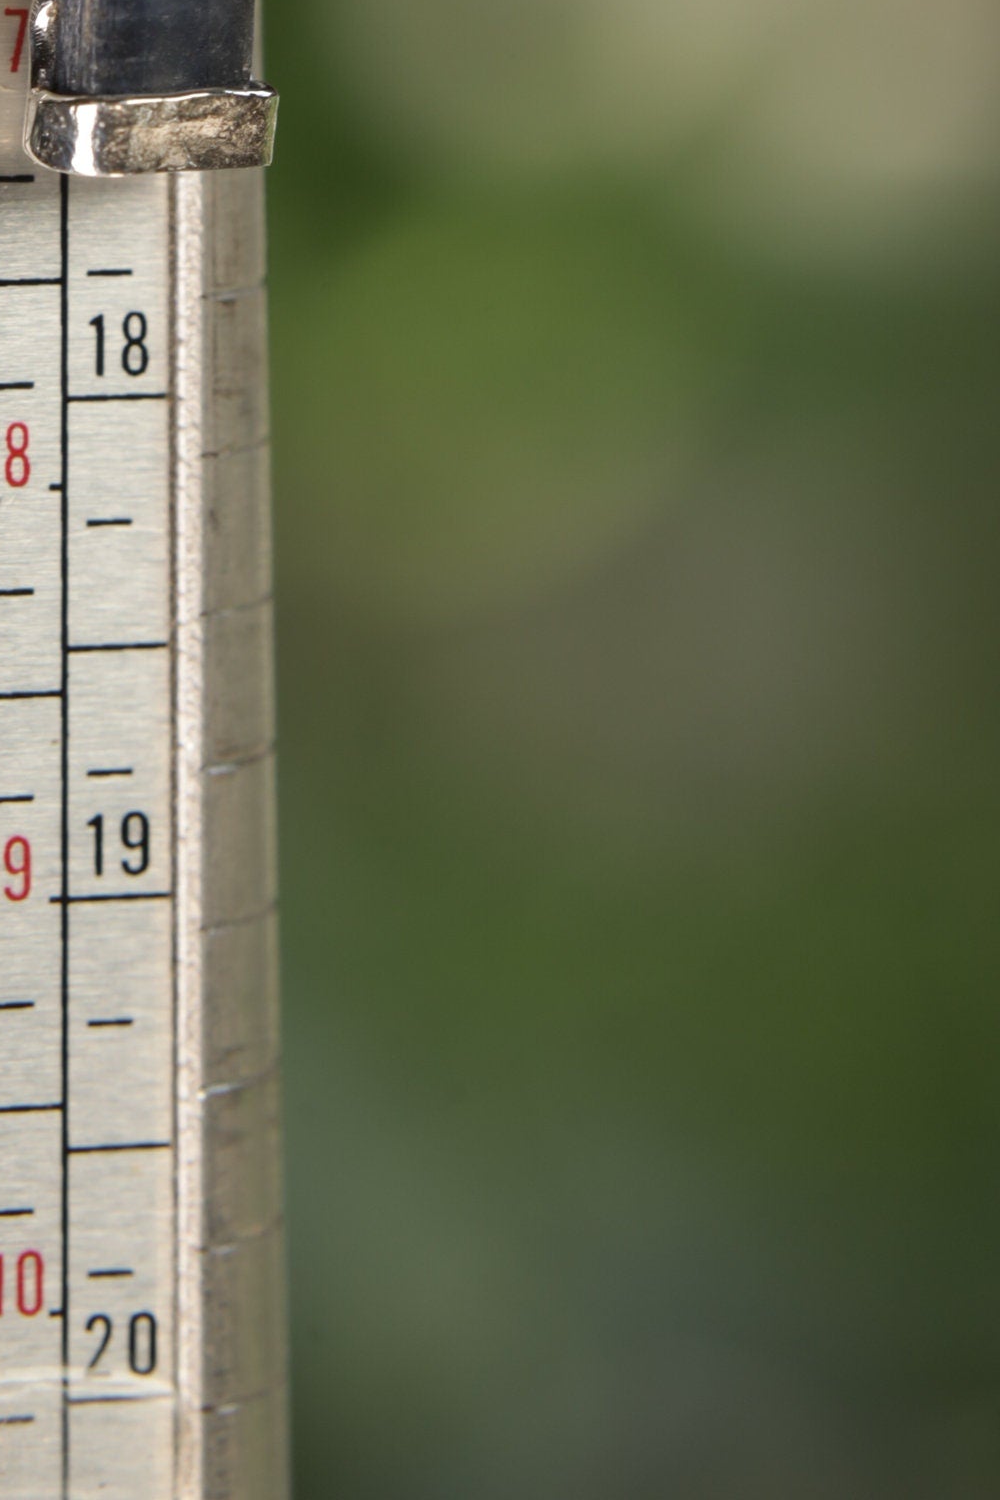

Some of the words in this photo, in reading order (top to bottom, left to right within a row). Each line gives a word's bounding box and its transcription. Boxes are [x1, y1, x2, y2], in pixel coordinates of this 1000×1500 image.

[4, 7, 30, 73] 7
[89, 312, 149, 377] 18
[4, 421, 32, 488] 8
[3, 835, 33, 903] 9
[87, 811, 150, 876] 19
[85, 1311, 157, 1376] 20
